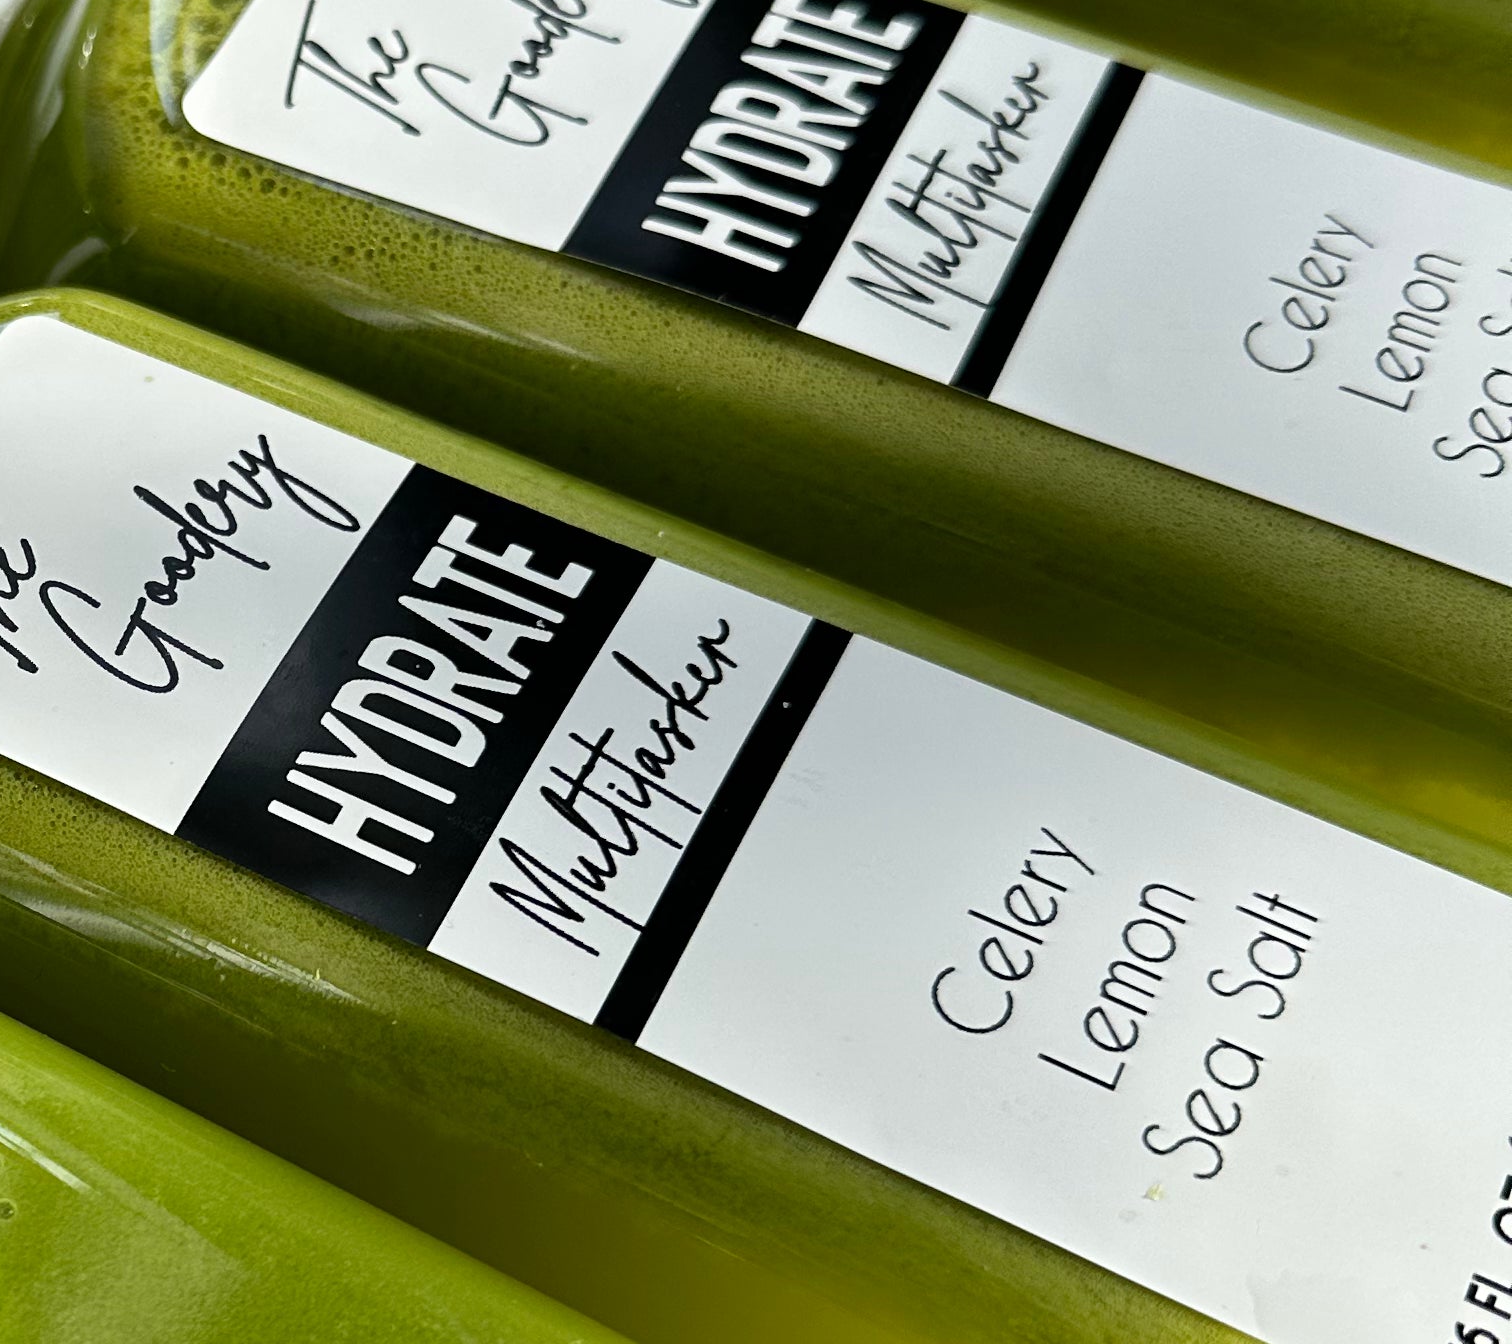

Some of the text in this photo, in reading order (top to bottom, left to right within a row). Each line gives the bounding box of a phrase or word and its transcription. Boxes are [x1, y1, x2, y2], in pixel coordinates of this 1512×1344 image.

[285, 0, 421, 136] The
[848, 63, 1047, 330] Multitasker
[1244, 215, 1373, 373] Celery
[1339, 254, 1461, 412] Lemon
[41, 435, 360, 693] Goodery
[268, 515, 592, 875] HYDRATE
[492, 619, 737, 957] Multitasker
[932, 828, 1094, 1034] Celery
[1038, 884, 1195, 1091] Lemon
[1143, 893, 1318, 1179] Sea Salt
